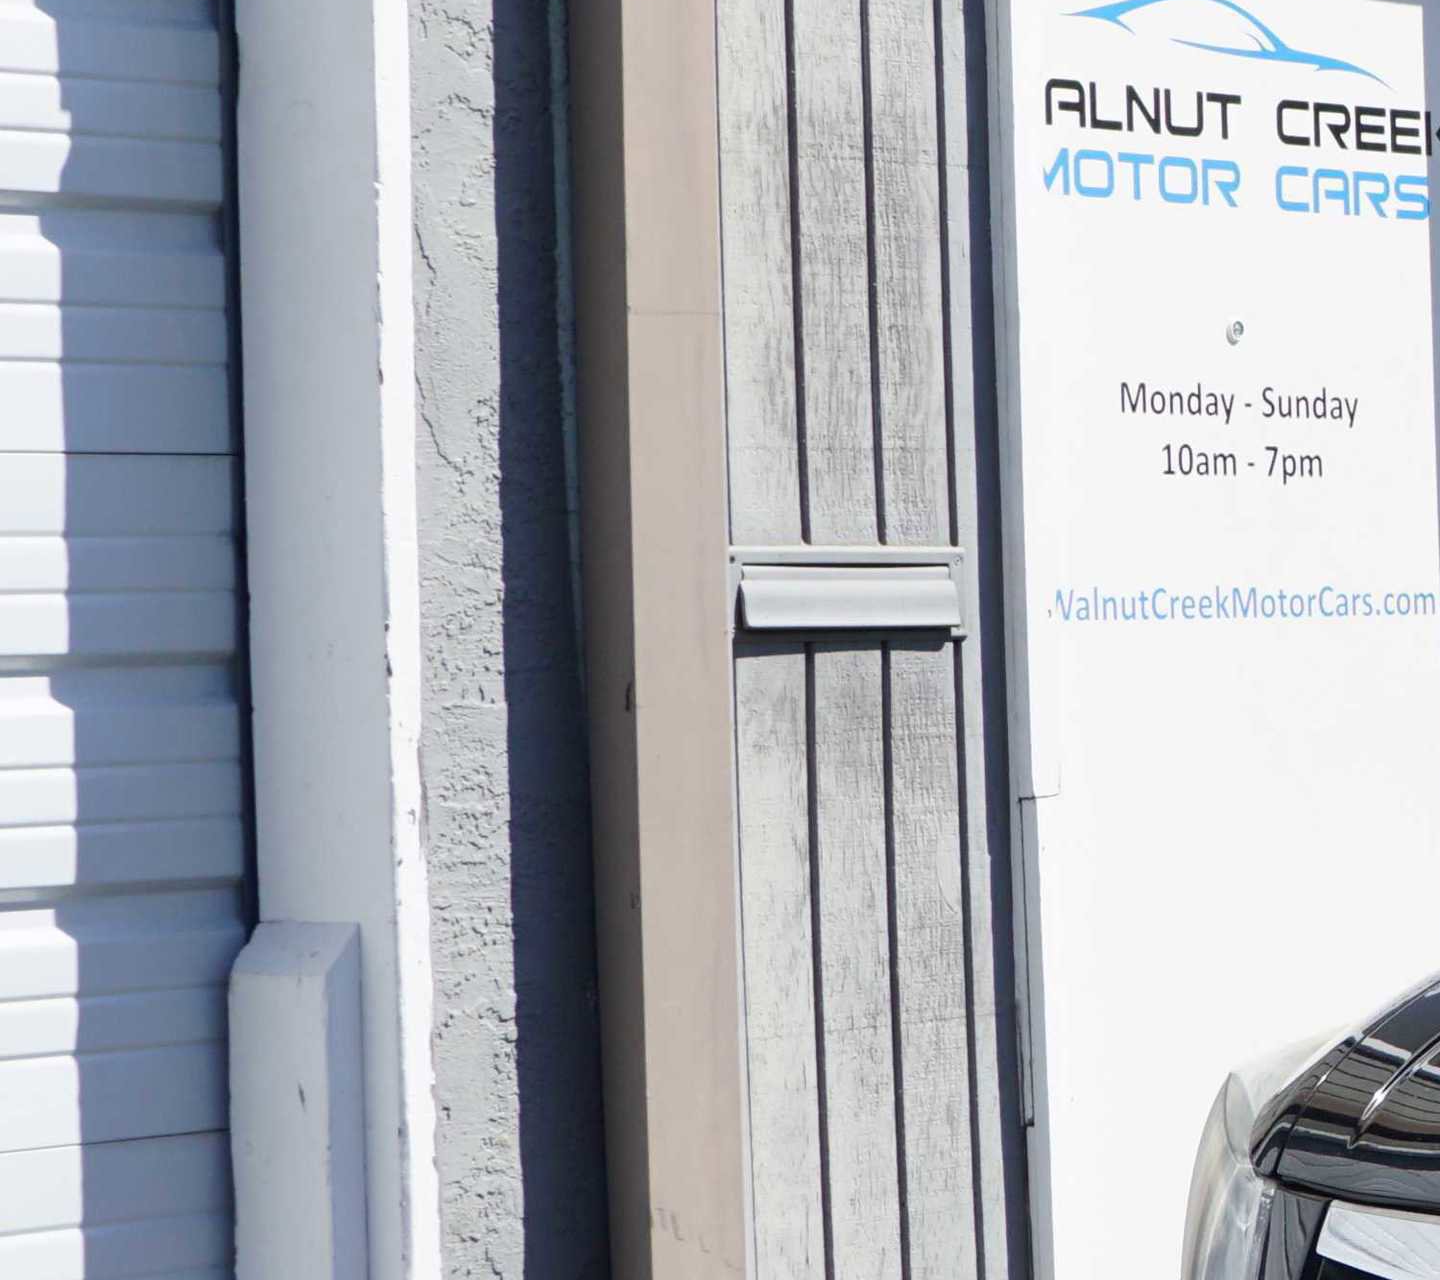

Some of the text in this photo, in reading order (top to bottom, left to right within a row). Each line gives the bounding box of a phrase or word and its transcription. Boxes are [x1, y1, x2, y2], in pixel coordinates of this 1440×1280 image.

[1045, 78, 1241, 140] ALNUT
[1275, 165, 1430, 221] CARS
[1120, 382, 1234, 424] Monday
[1261, 386, 1358, 428] Sunday
[1161, 443, 1238, 476] 10am
[1264, 446, 1323, 485] 7pm
